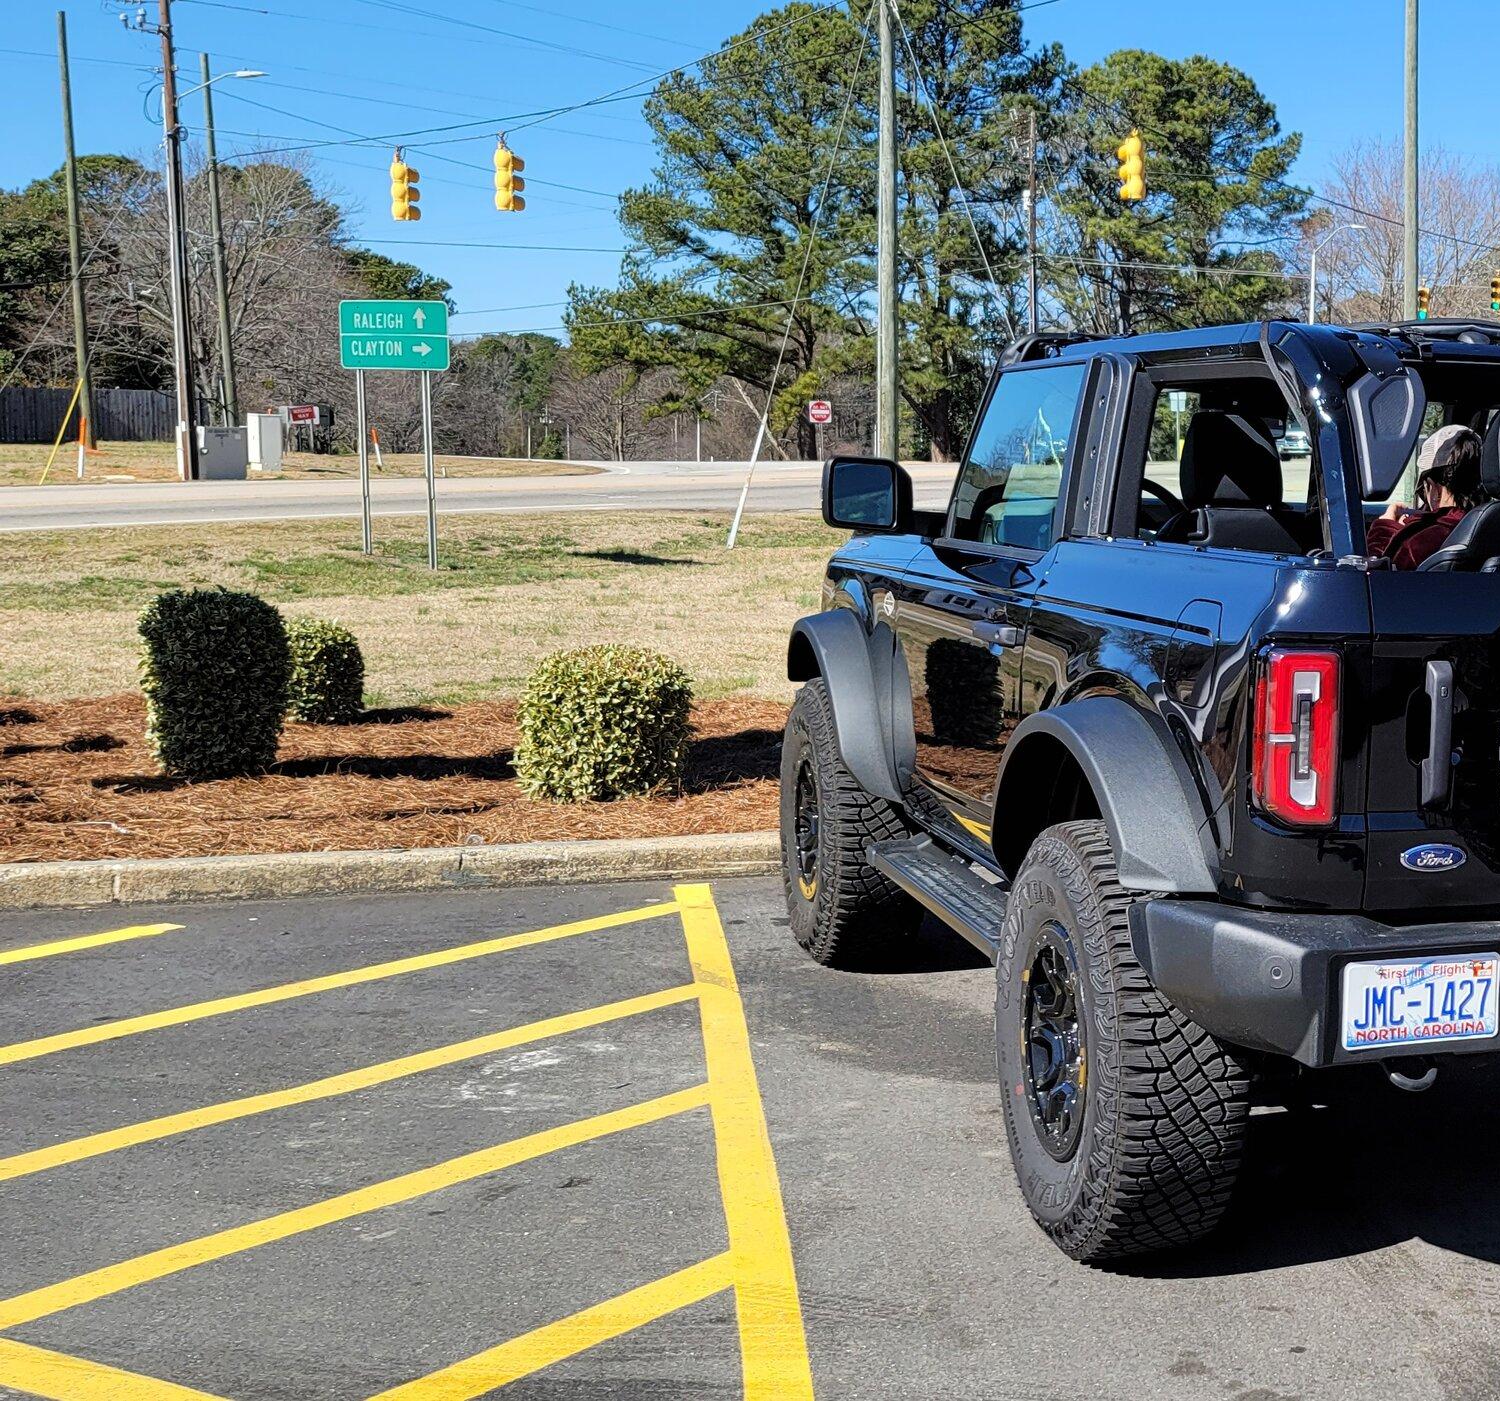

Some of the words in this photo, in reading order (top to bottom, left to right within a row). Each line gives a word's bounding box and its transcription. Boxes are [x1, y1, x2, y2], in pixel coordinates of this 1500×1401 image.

[353, 313, 403, 329] RALEIGH
[351, 340, 402, 356] CLAYTON
[1416, 851, 1454, 867] Ford
[1379, 968, 1408, 980] First
[1433, 964, 1467, 977] Flight
[1354, 978, 1492, 1030] JMC-1427
[1356, 1026, 1408, 1043] NORTH
[1413, 1020, 1486, 1037] CAROLINA
